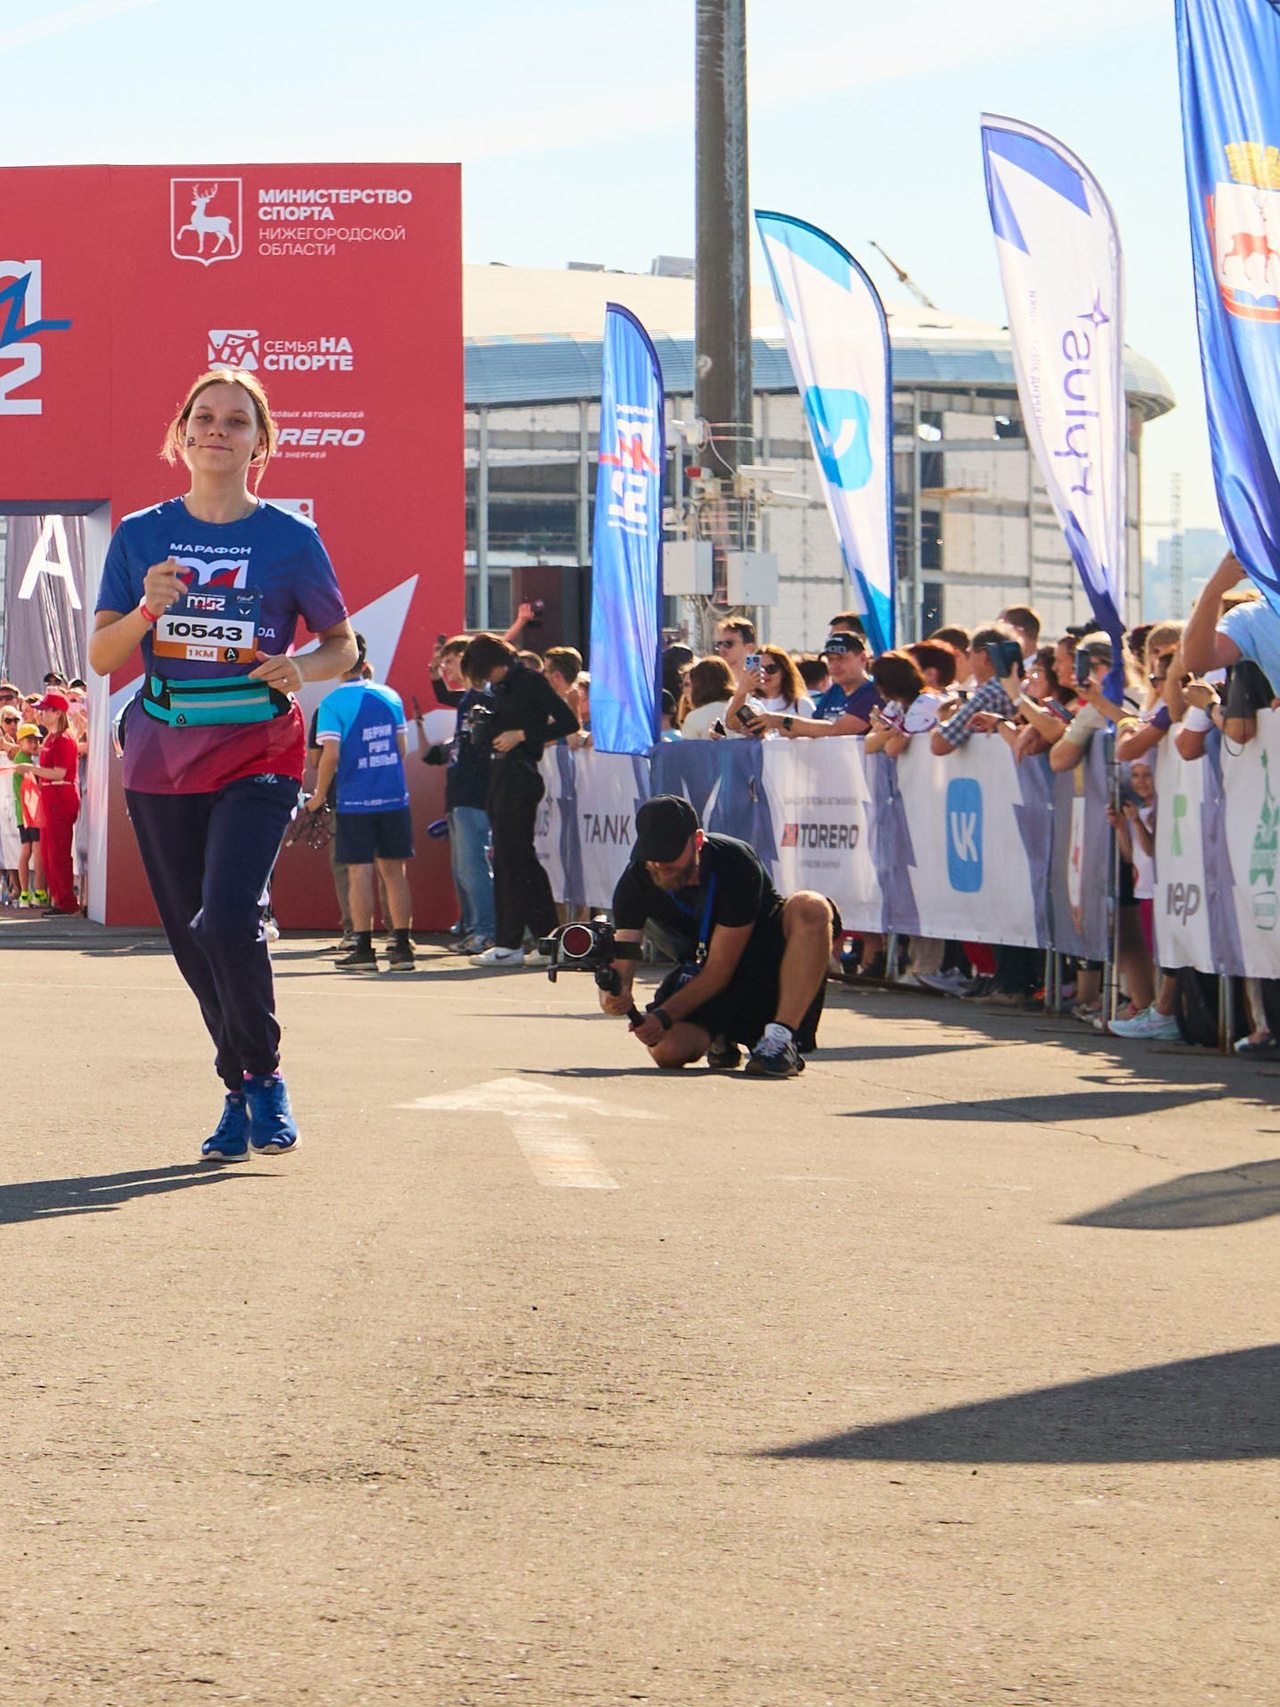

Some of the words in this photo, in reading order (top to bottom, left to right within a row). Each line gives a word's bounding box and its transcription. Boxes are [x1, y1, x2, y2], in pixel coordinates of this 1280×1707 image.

[258, 189, 413, 205] МИНИСТЕРСТВО
[258, 206, 334, 221] СПОРТА
[258, 225, 406, 242] НИЖЕГОРОДСКОЙ
[258, 243, 336, 256] ОБЛАСТИ
[263, 340, 318, 354] СЕМЬЯ
[320, 337, 353, 353] НА
[263, 355, 354, 371] СПОРТЕ
[302, 410, 365, 419] АВТОМОБИЛЕЙ
[275, 428, 365, 446] RERO
[170, 542, 252, 555] МАРАФОН
[166, 621, 243, 641] 10543
[583, 814, 630, 845] TANK
[800, 823, 859, 849] TORERO
[951, 812, 978, 863] VK
